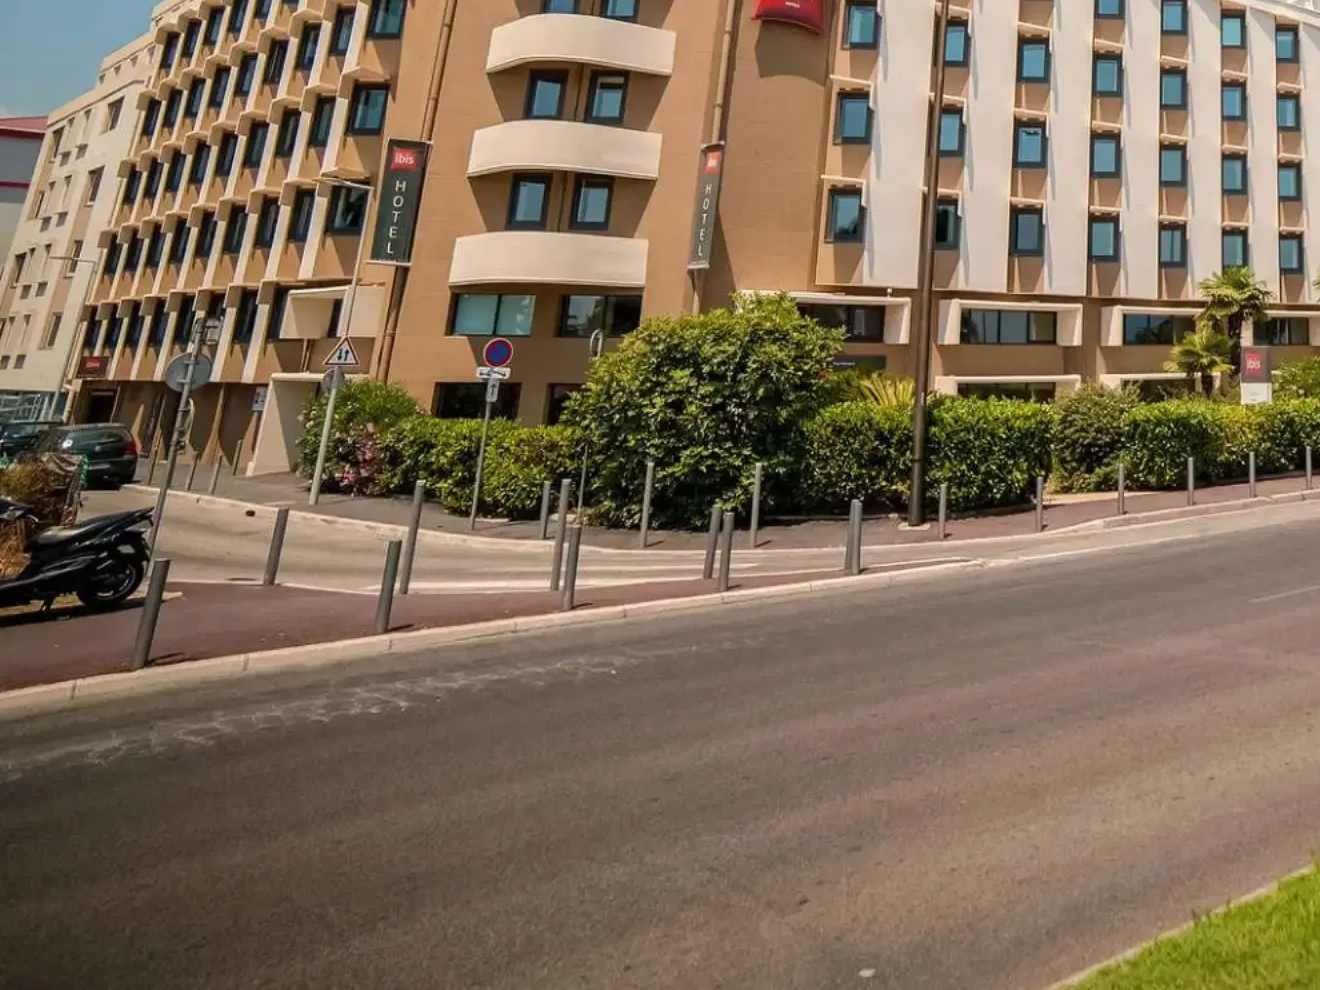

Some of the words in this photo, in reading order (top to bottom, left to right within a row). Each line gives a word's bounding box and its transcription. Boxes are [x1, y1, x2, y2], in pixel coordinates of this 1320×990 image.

[395, 152, 415, 164] ibis
[387, 180, 406, 254] HOTEL
[698, 182, 712, 256] HOTEL
